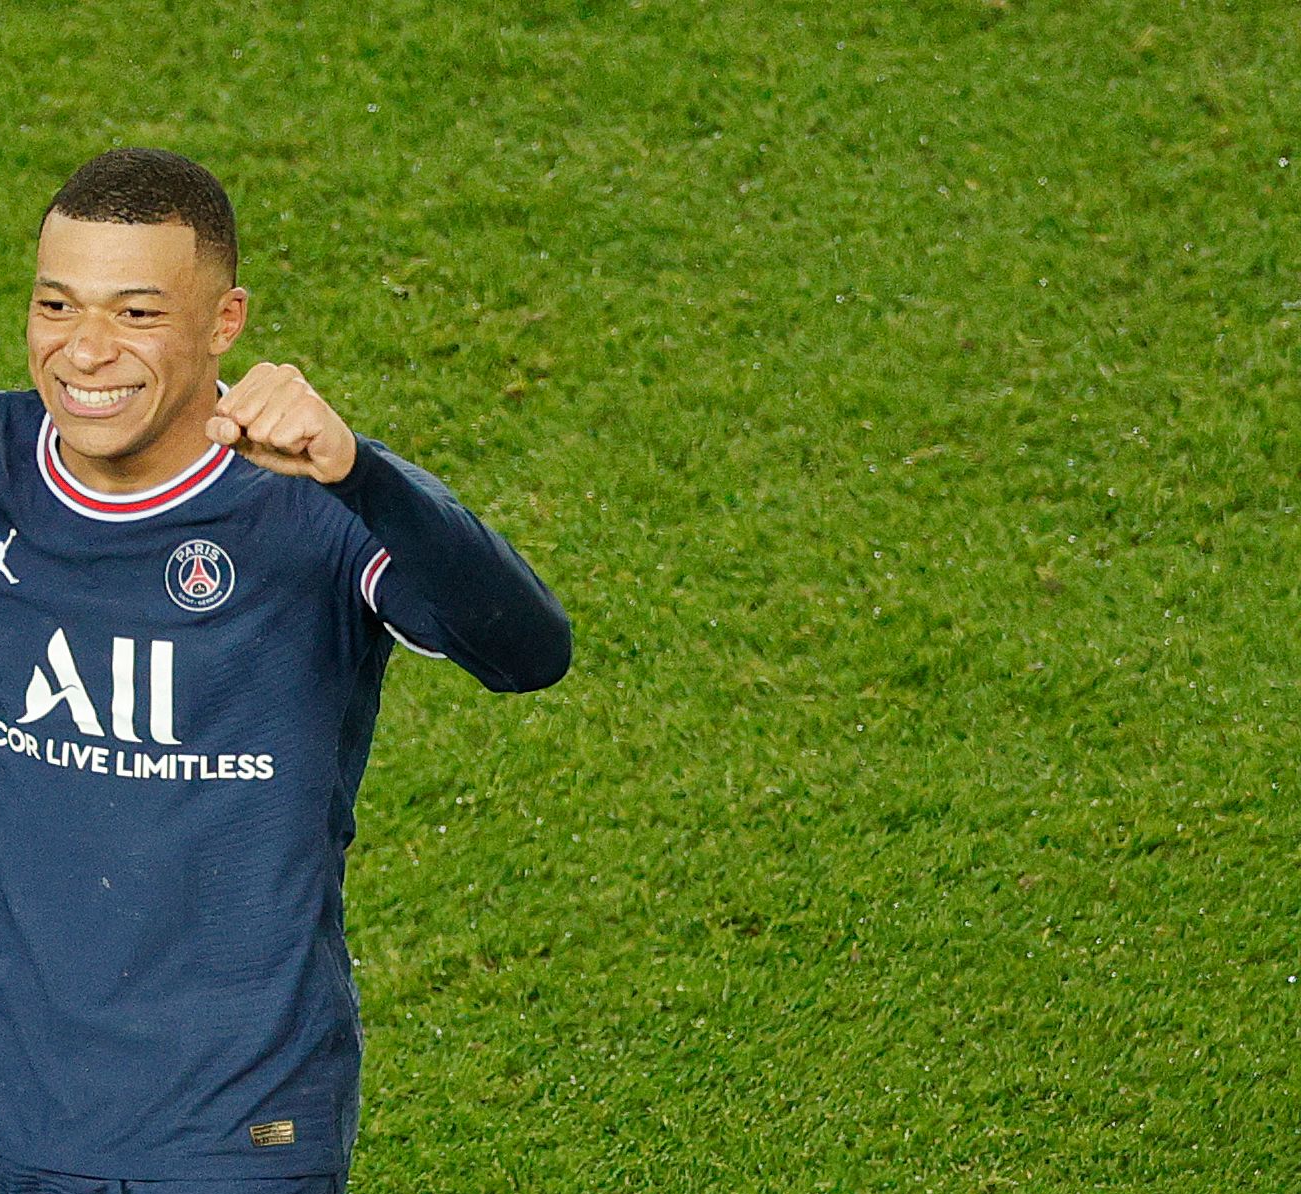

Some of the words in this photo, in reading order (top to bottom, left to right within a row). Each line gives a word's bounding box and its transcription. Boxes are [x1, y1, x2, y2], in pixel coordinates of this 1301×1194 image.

[175, 543, 221, 563] PARIS
[46, 738, 110, 774] LIVE
[116, 751, 274, 780] LIMITLESS
